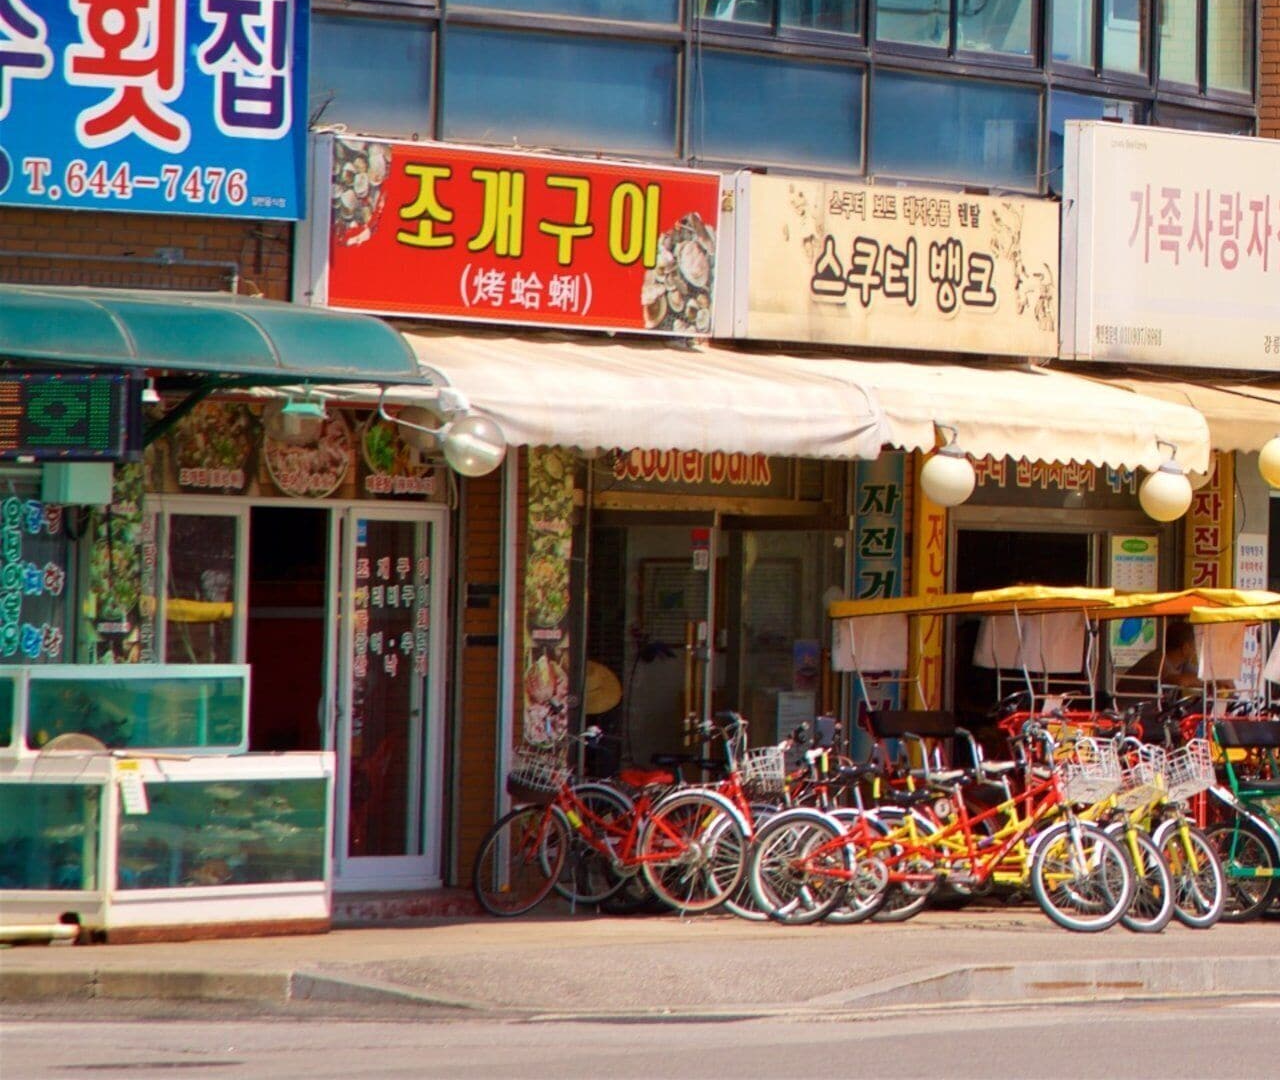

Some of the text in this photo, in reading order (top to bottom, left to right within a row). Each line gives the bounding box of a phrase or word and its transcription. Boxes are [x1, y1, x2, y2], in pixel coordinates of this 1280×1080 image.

[22, 156, 249, 206] T.644-7476
[396, 163, 661, 271] 조개구이
[811, 233, 998, 314] 스쿠터 뱅크
[860, 483, 900, 600] 자전거
